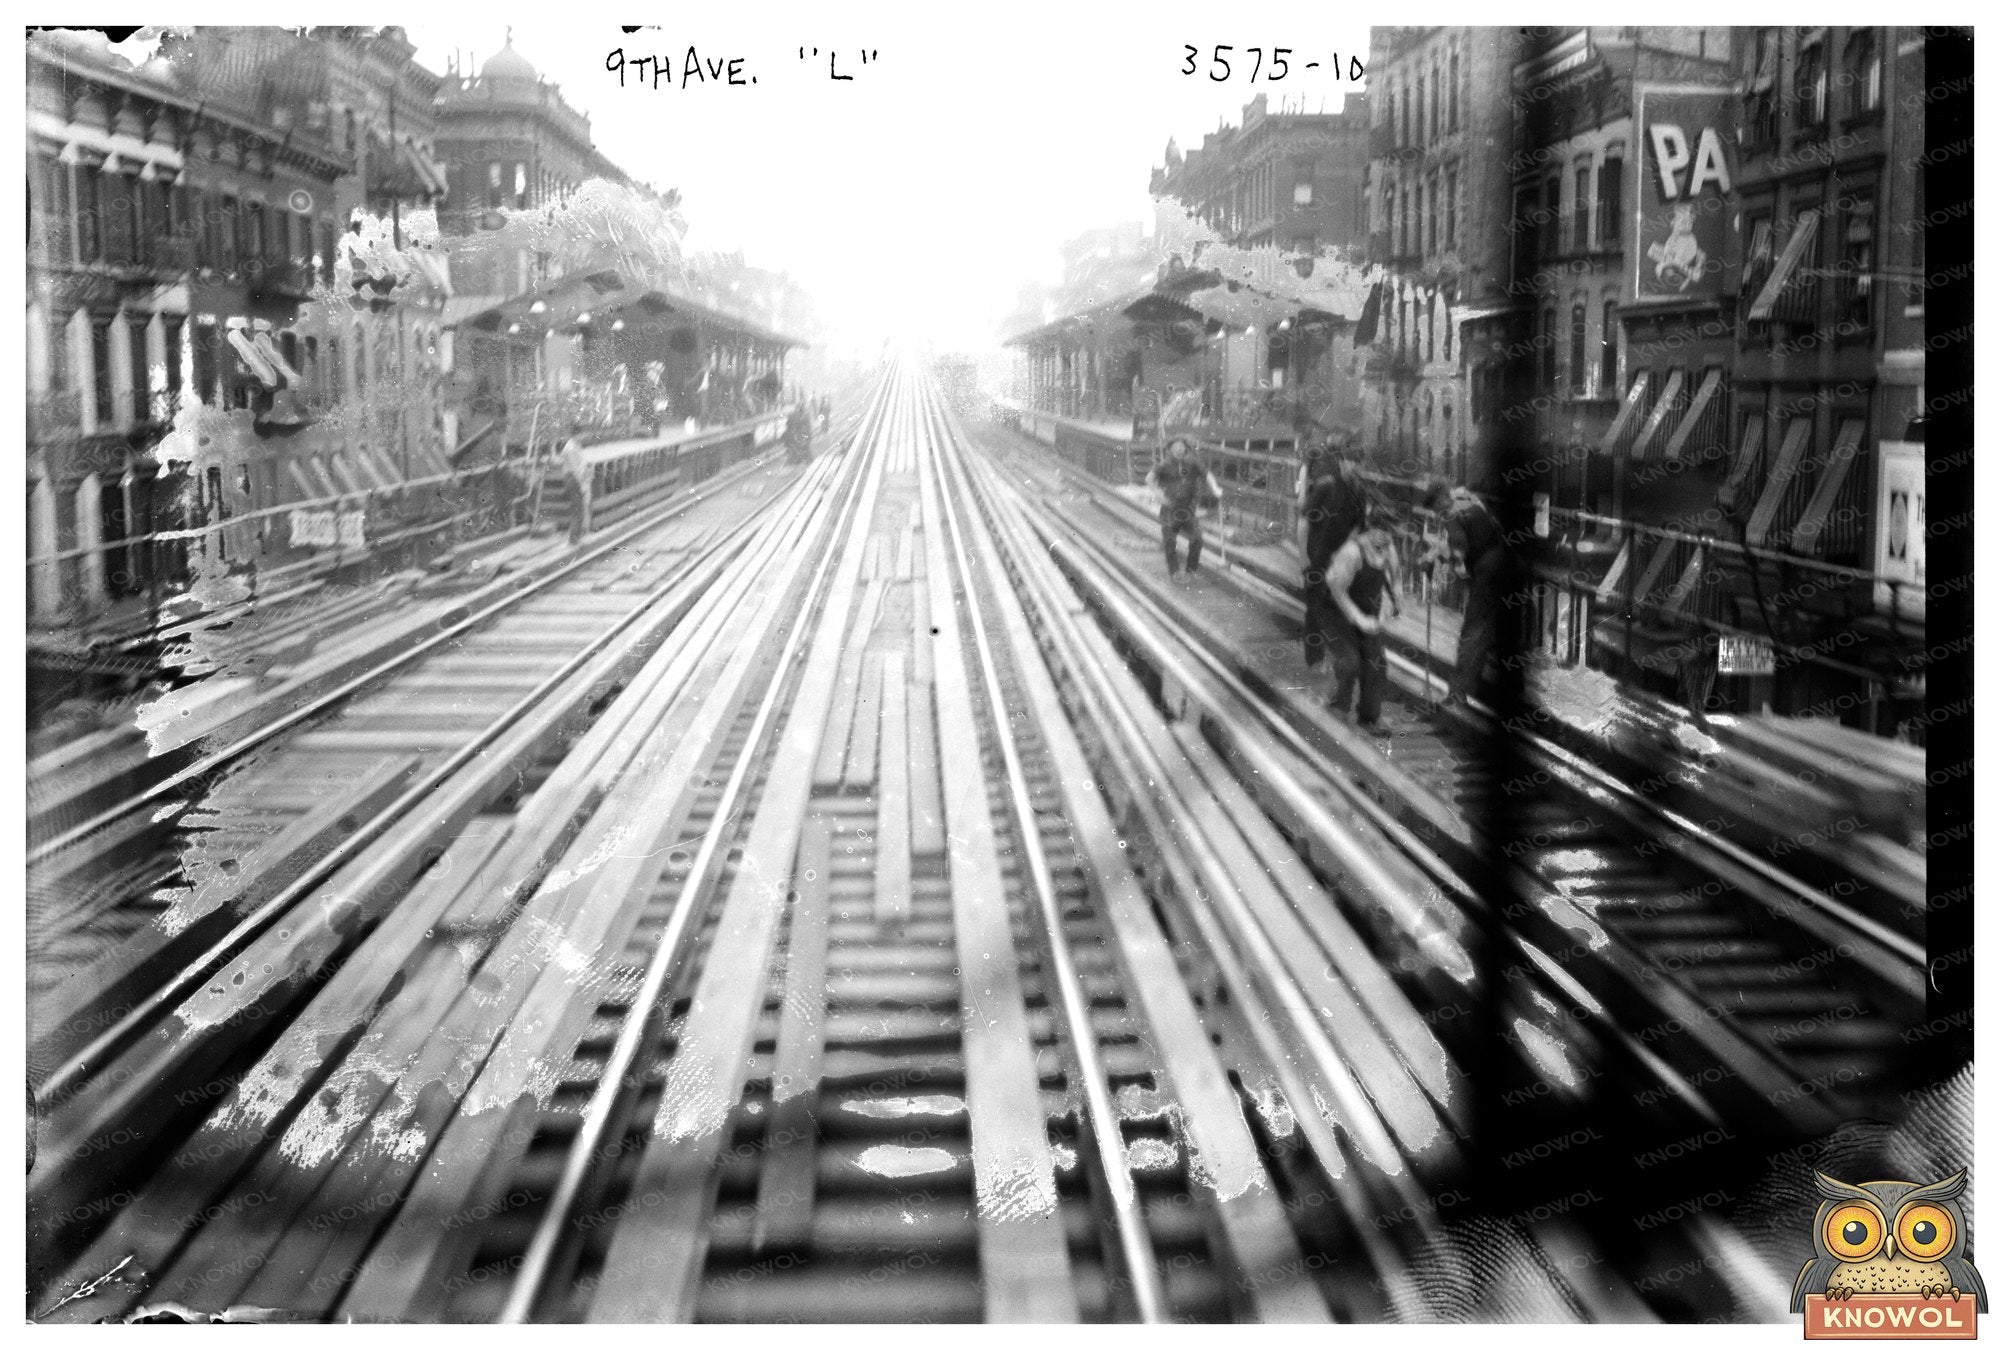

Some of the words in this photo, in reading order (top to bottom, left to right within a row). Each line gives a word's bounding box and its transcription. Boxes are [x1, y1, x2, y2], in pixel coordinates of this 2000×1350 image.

[606, 47, 671, 90] 9TH
[682, 45, 758, 89] AVE.
[1181, 44, 1364, 83] 3575-10
